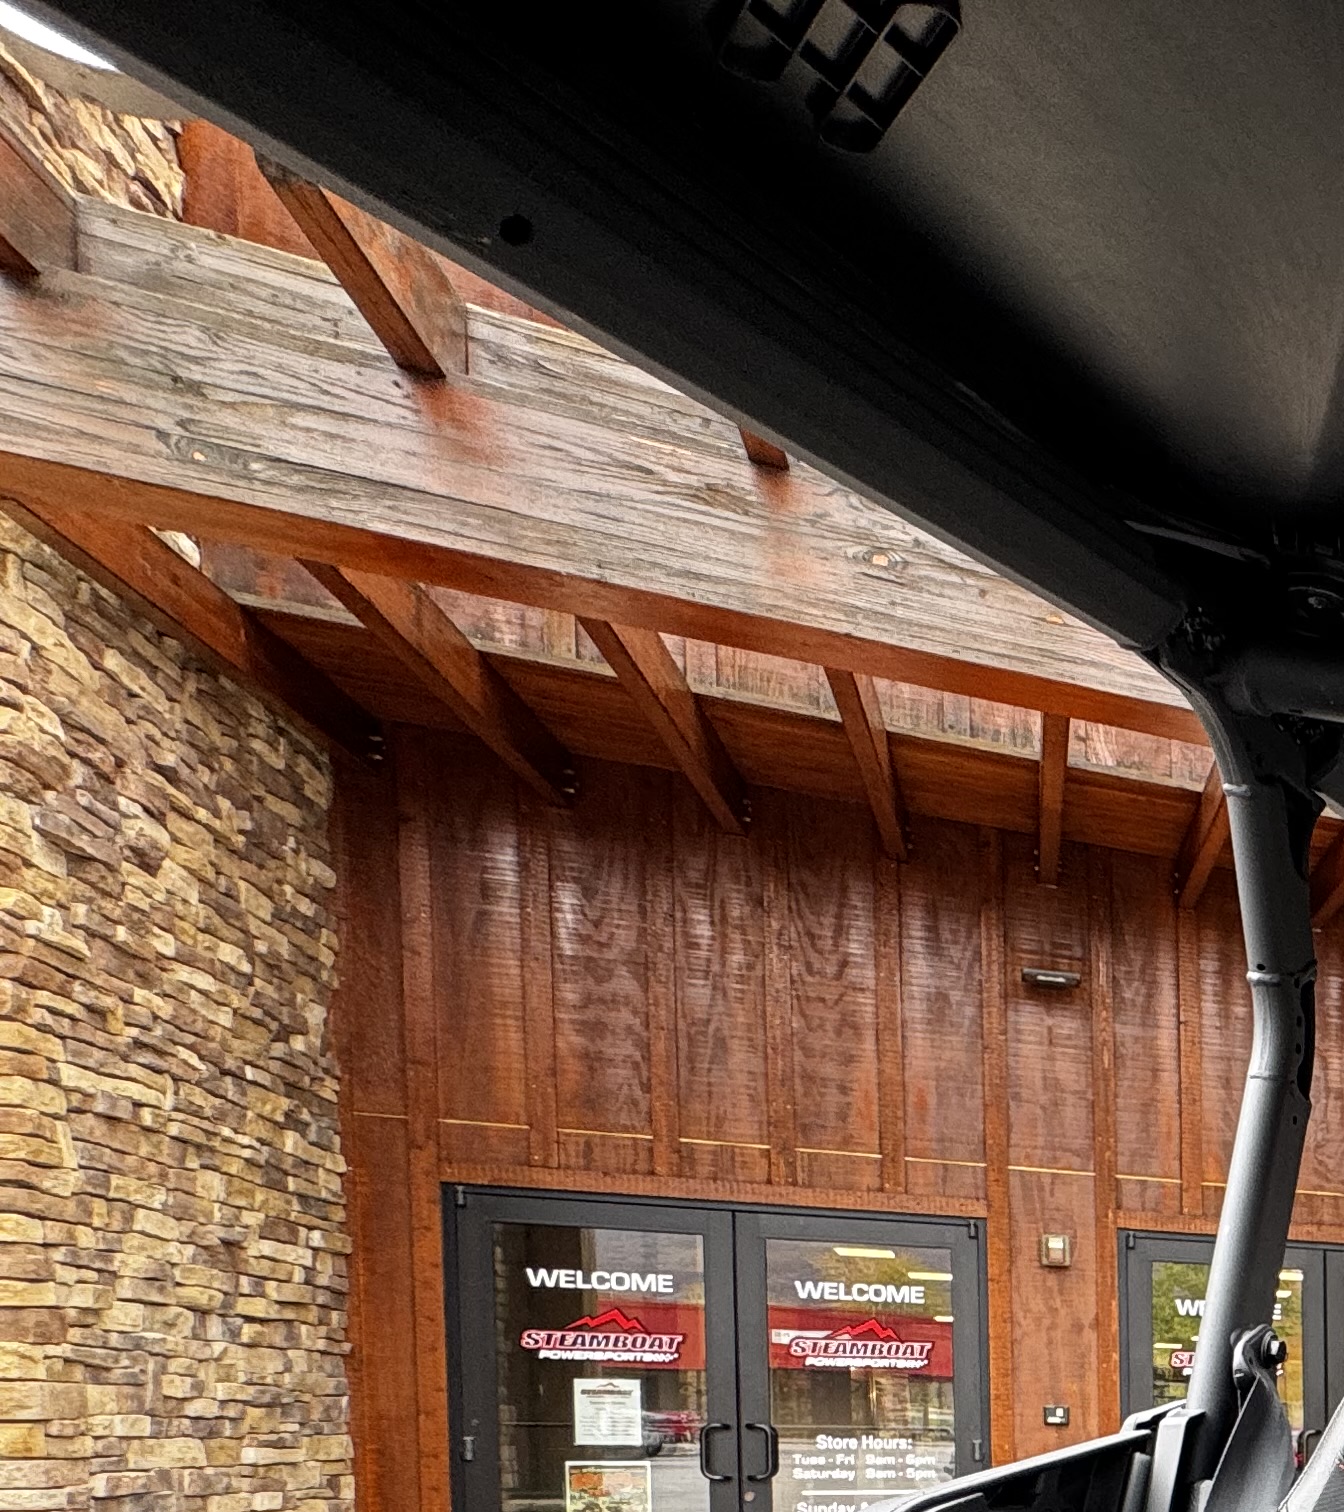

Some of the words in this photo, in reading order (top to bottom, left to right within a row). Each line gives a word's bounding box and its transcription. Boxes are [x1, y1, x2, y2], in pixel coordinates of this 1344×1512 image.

[526, 1267, 674, 1293] WELCOME
[794, 1280, 925, 1304] WELCOME
[521, 1329, 683, 1351] STEAMBOAT
[790, 1338, 933, 1359] STEAMBOAT
[538, 1350, 656, 1361] POWERSPORTS
[816, 1434, 858, 1450] Store
[861, 1435, 913, 1450] Hours:
[835, 1454, 855, 1465] Fri
[792, 1468, 856, 1481] Saturday
